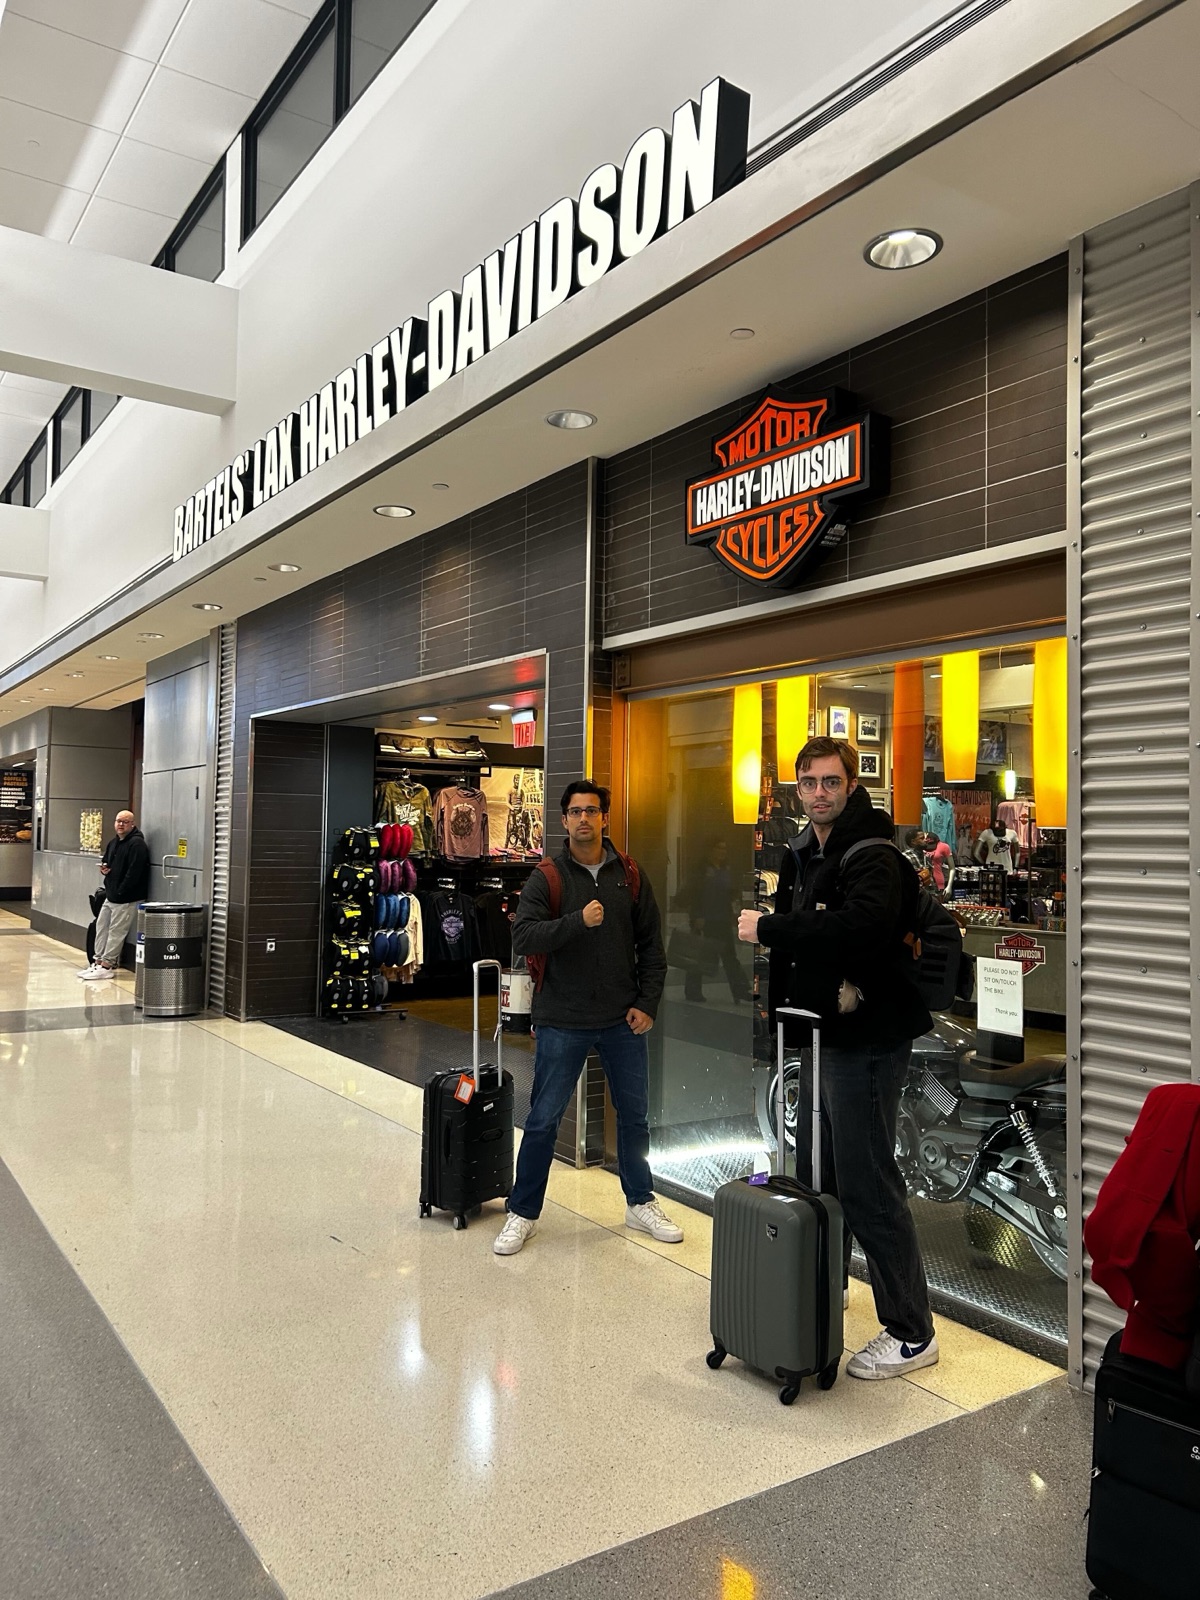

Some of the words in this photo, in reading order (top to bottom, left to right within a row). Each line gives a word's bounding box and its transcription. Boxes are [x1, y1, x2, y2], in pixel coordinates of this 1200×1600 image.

[172, 449, 250, 563] BARTELS'
[253, 412, 295, 509] LAX
[300, 76, 722, 478] HARLEY-DAVIDSON
[729, 407, 811, 466] MOTOR
[696, 435, 850, 526] HARLEY-DAVIDSON
[726, 503, 810, 568] CYCLES
[998, 948, 1041, 959] HARLEY-DAVIDSON
[1008, 938, 1031, 947] MOTOR
[983, 966, 1000, 974] PLEASE
[991, 978, 1017, 986] ON/TOUCH
